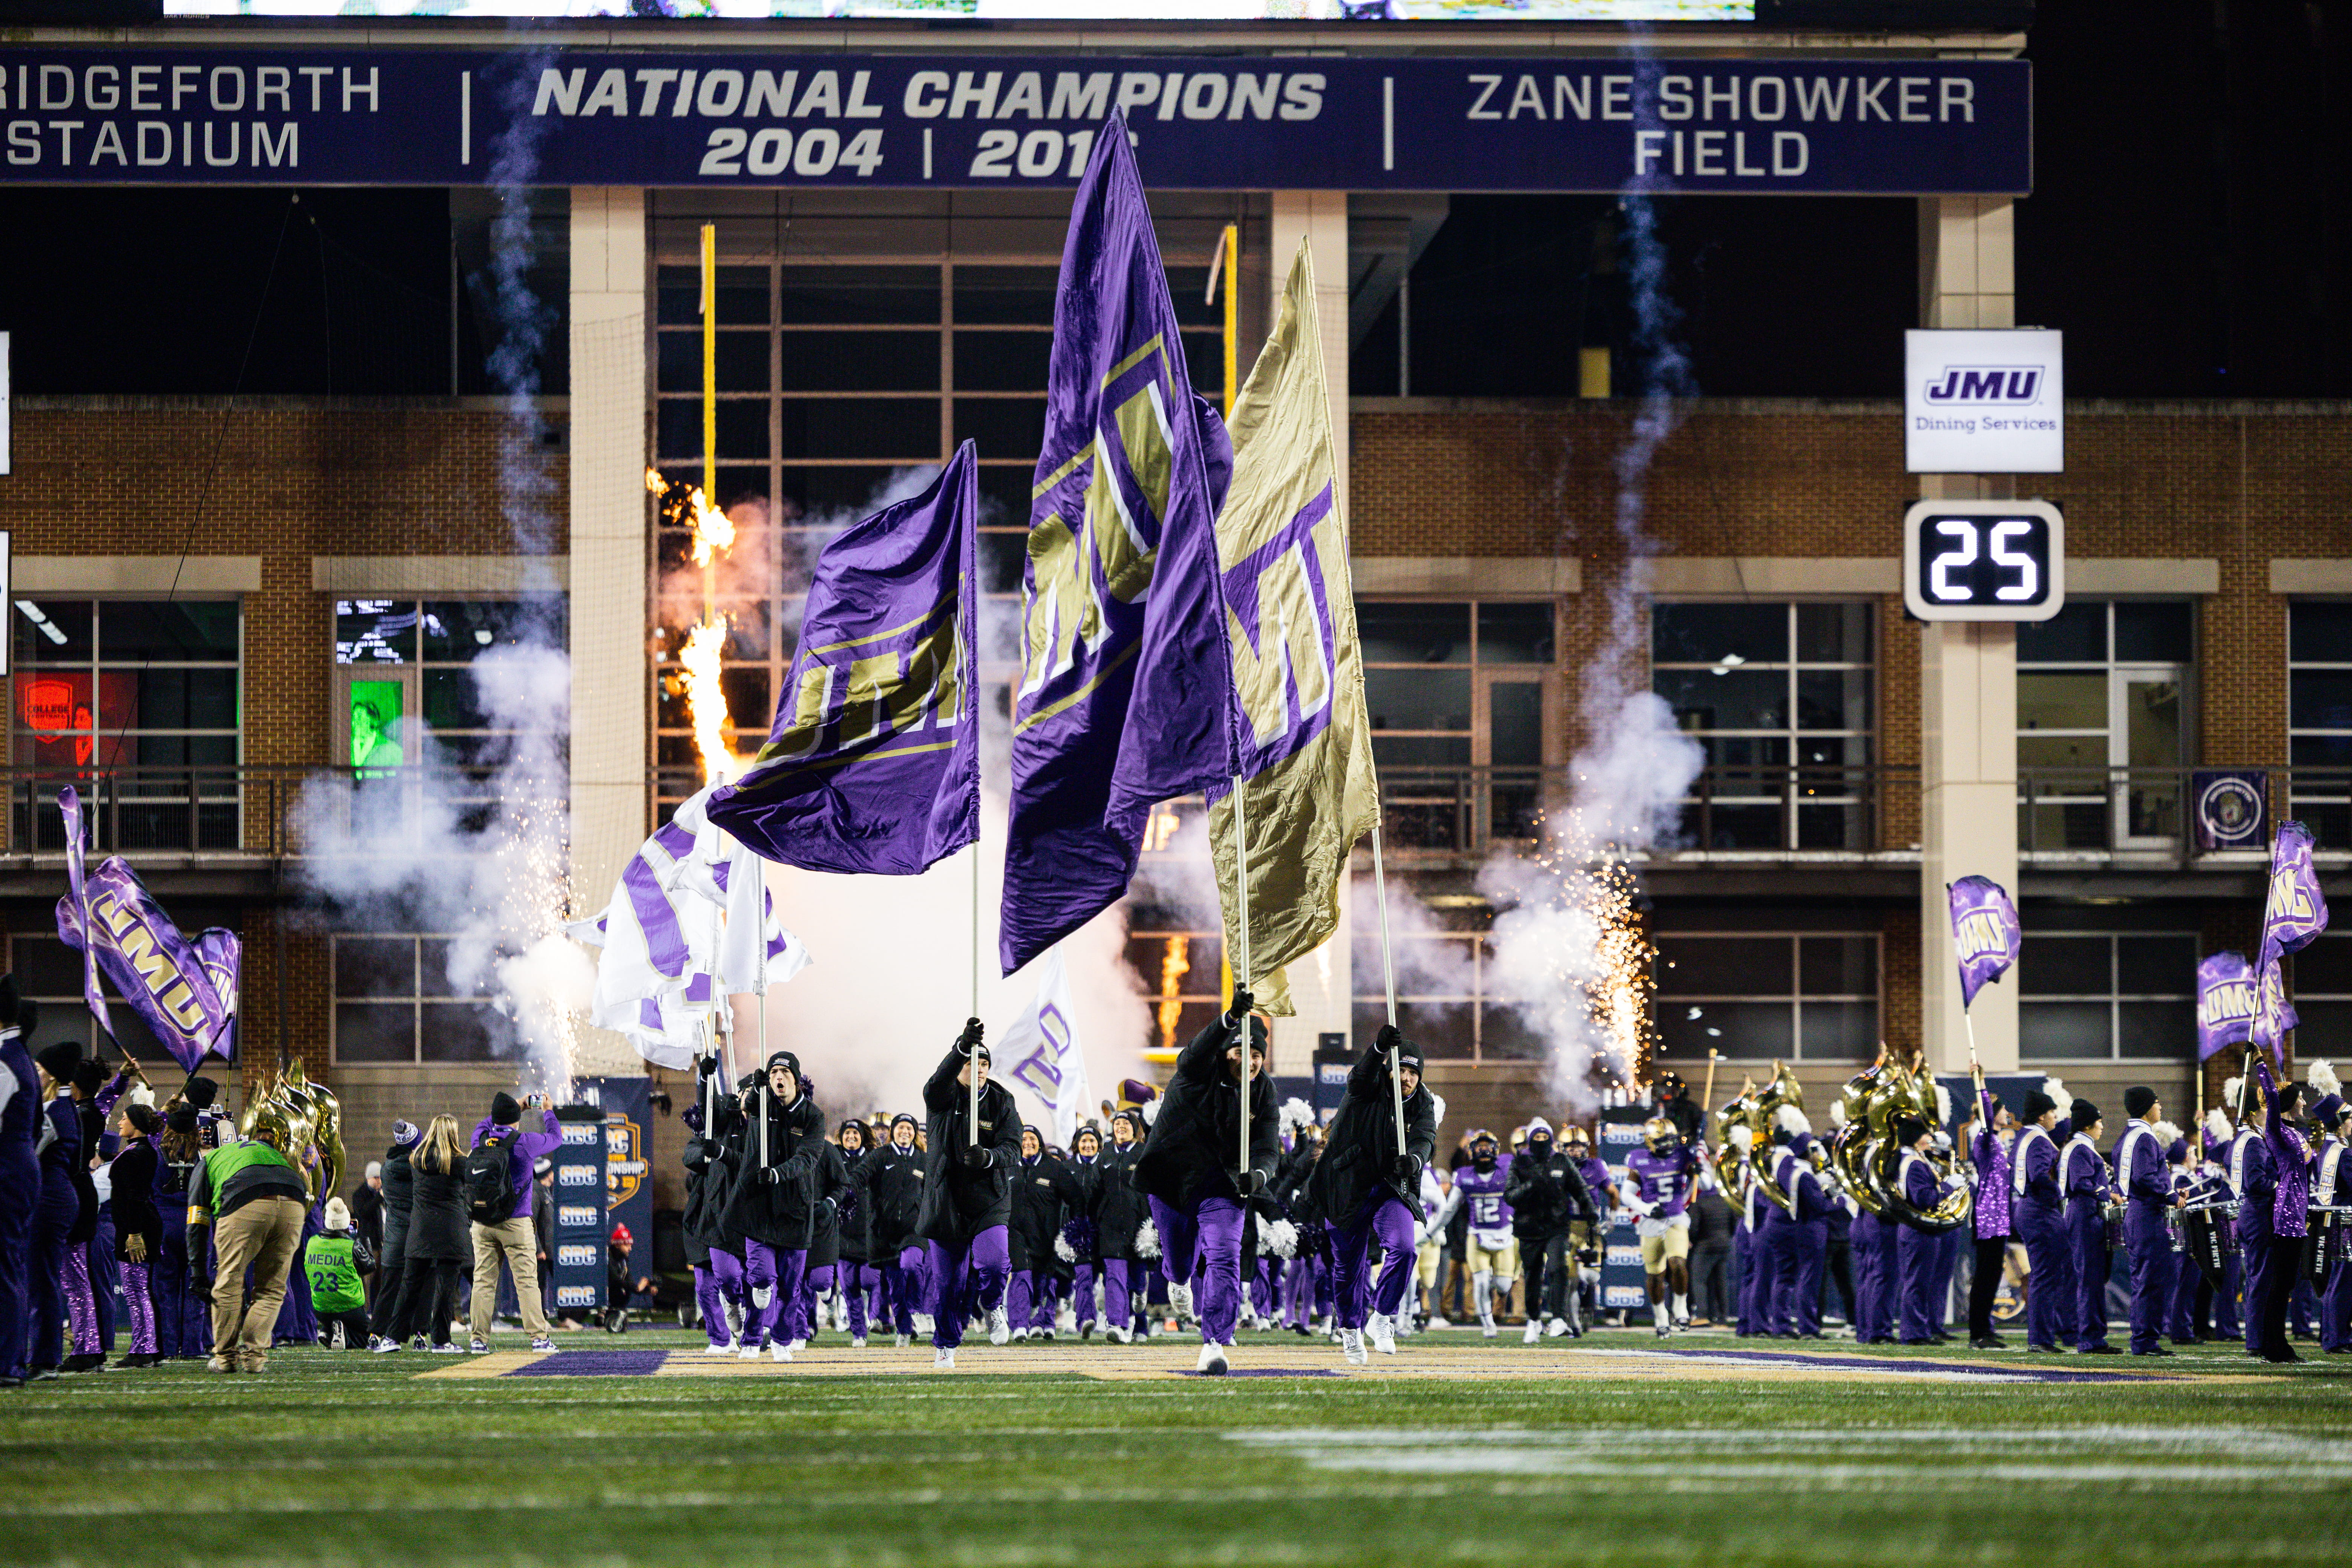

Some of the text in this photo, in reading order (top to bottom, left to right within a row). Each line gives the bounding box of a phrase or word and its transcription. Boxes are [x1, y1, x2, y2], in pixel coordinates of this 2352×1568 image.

[0, 65, 378, 112] IDGEFORTH
[531, 67, 1326, 121] NATIONAL CHAMPIONS
[1467, 75, 1974, 122] ZANE SHOWKER
[8, 121, 298, 167] STADIUM
[699, 127, 1138, 178] 2004 201
[1635, 129, 1808, 176] FIELD
[1930, 372, 2037, 399] JMU
[1916, 416, 2056, 434] Dining Services
[1931, 521, 2037, 600] 25
[98, 899, 207, 1031] JMU
[2233, 1148, 2242, 1182] JMU
[1475, 1198, 1501, 1223] 12
[1658, 1177, 1674, 1203] 5
[308, 1254, 347, 1267] MEDIA
[313, 1271, 339, 1292] 23
